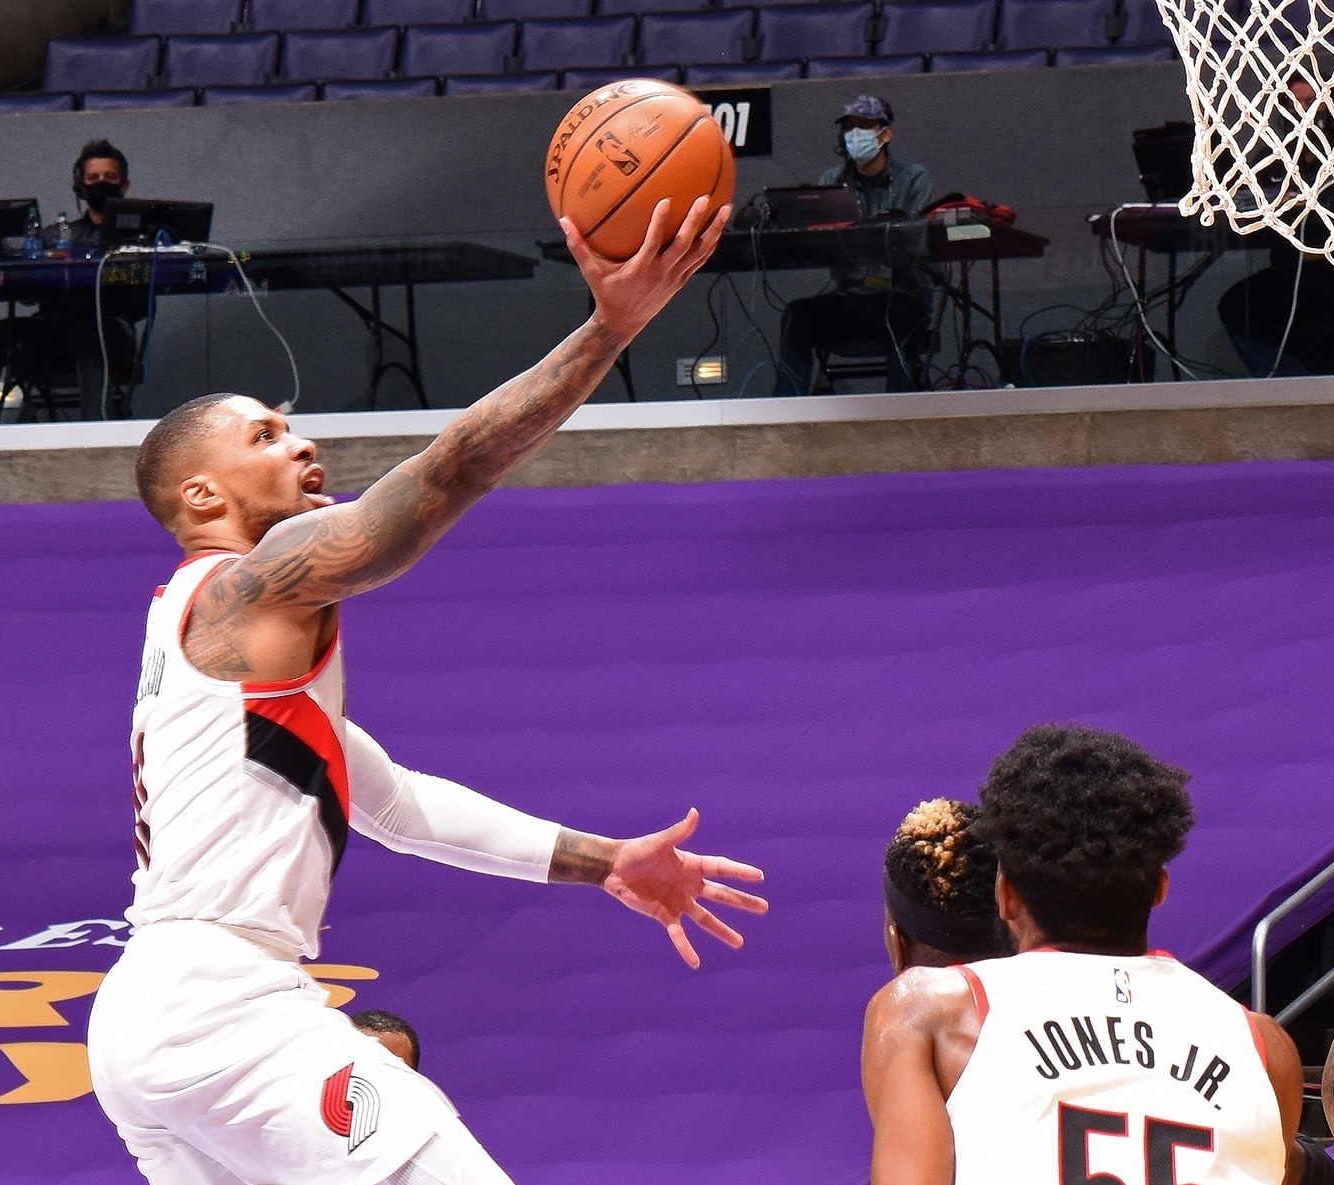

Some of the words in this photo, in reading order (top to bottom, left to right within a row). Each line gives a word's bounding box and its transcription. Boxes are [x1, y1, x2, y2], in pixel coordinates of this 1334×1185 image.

[701, 102, 751, 147] 01
[1024, 1015, 1155, 1080] JONES
[1170, 1044, 1231, 1111] JR.
